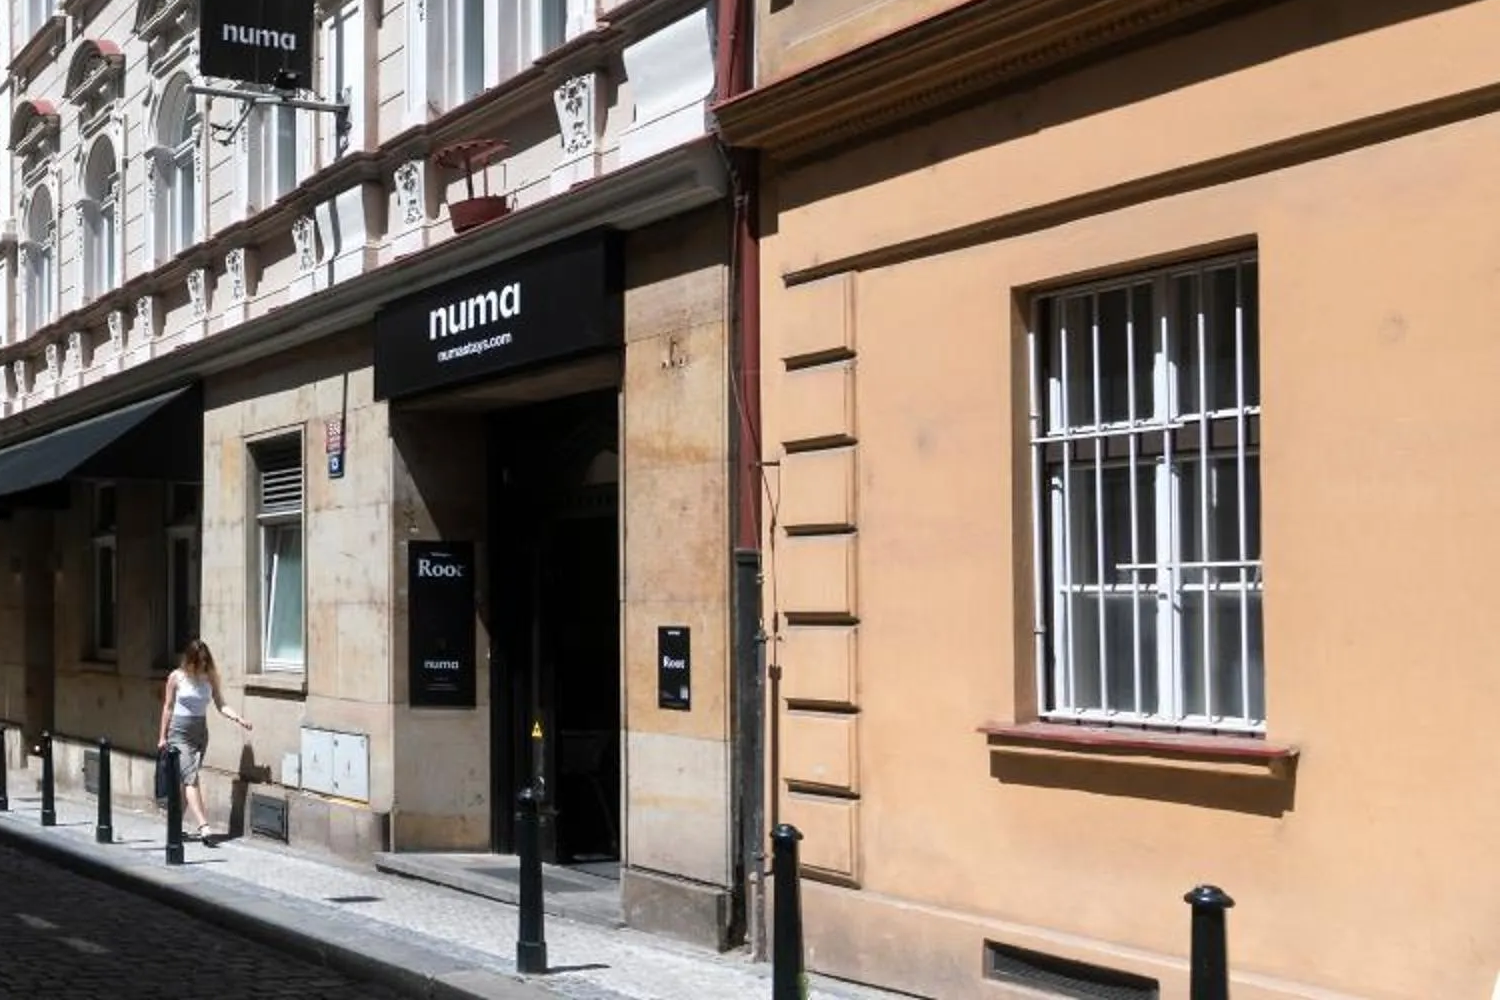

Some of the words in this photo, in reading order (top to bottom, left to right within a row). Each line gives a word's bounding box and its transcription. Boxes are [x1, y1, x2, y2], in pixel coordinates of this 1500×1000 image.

[222, 19, 296, 51] numa
[429, 281, 521, 340] numa
[437, 332, 513, 363] numastays.com
[424, 659, 460, 670] numa
